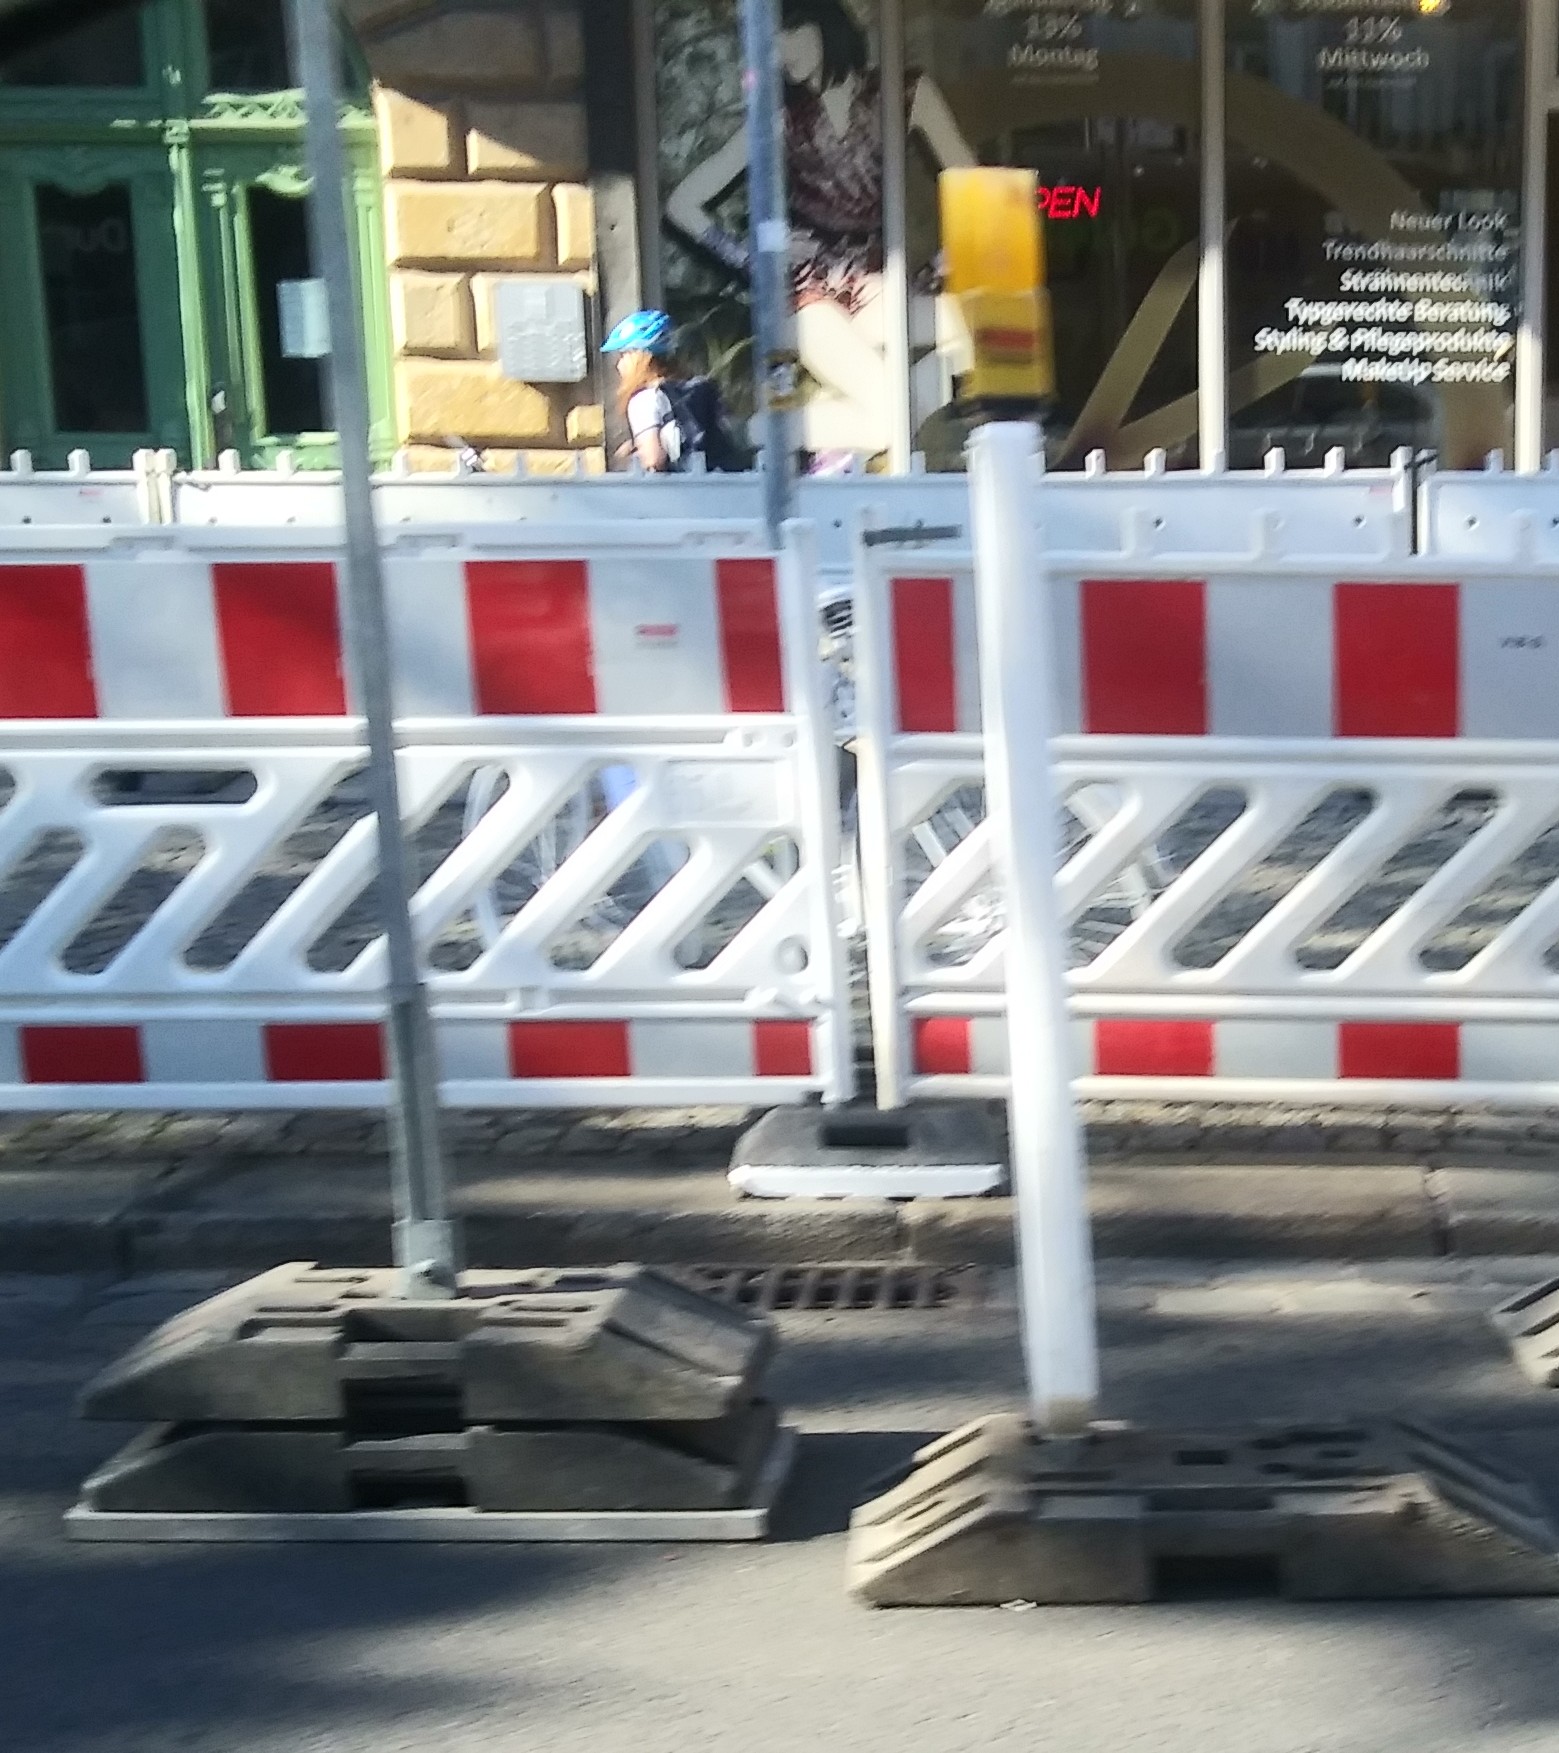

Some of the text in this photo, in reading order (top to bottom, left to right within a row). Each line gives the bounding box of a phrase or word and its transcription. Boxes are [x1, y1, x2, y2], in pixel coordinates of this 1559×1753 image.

[1007, 44, 1099, 71] Montag
[1315, 46, 1430, 71] Mittwoch
[1036, 186, 1102, 218] PEN
[1390, 209, 1508, 230] Neuer Look
[1322, 238, 1509, 260] Trendhaarschnitte
[1284, 297, 1512, 327] Typgerechte Beratung
[1254, 326, 1512, 356] Styling & Pflegeprodukte
[1432, 357, 1511, 382] Service
